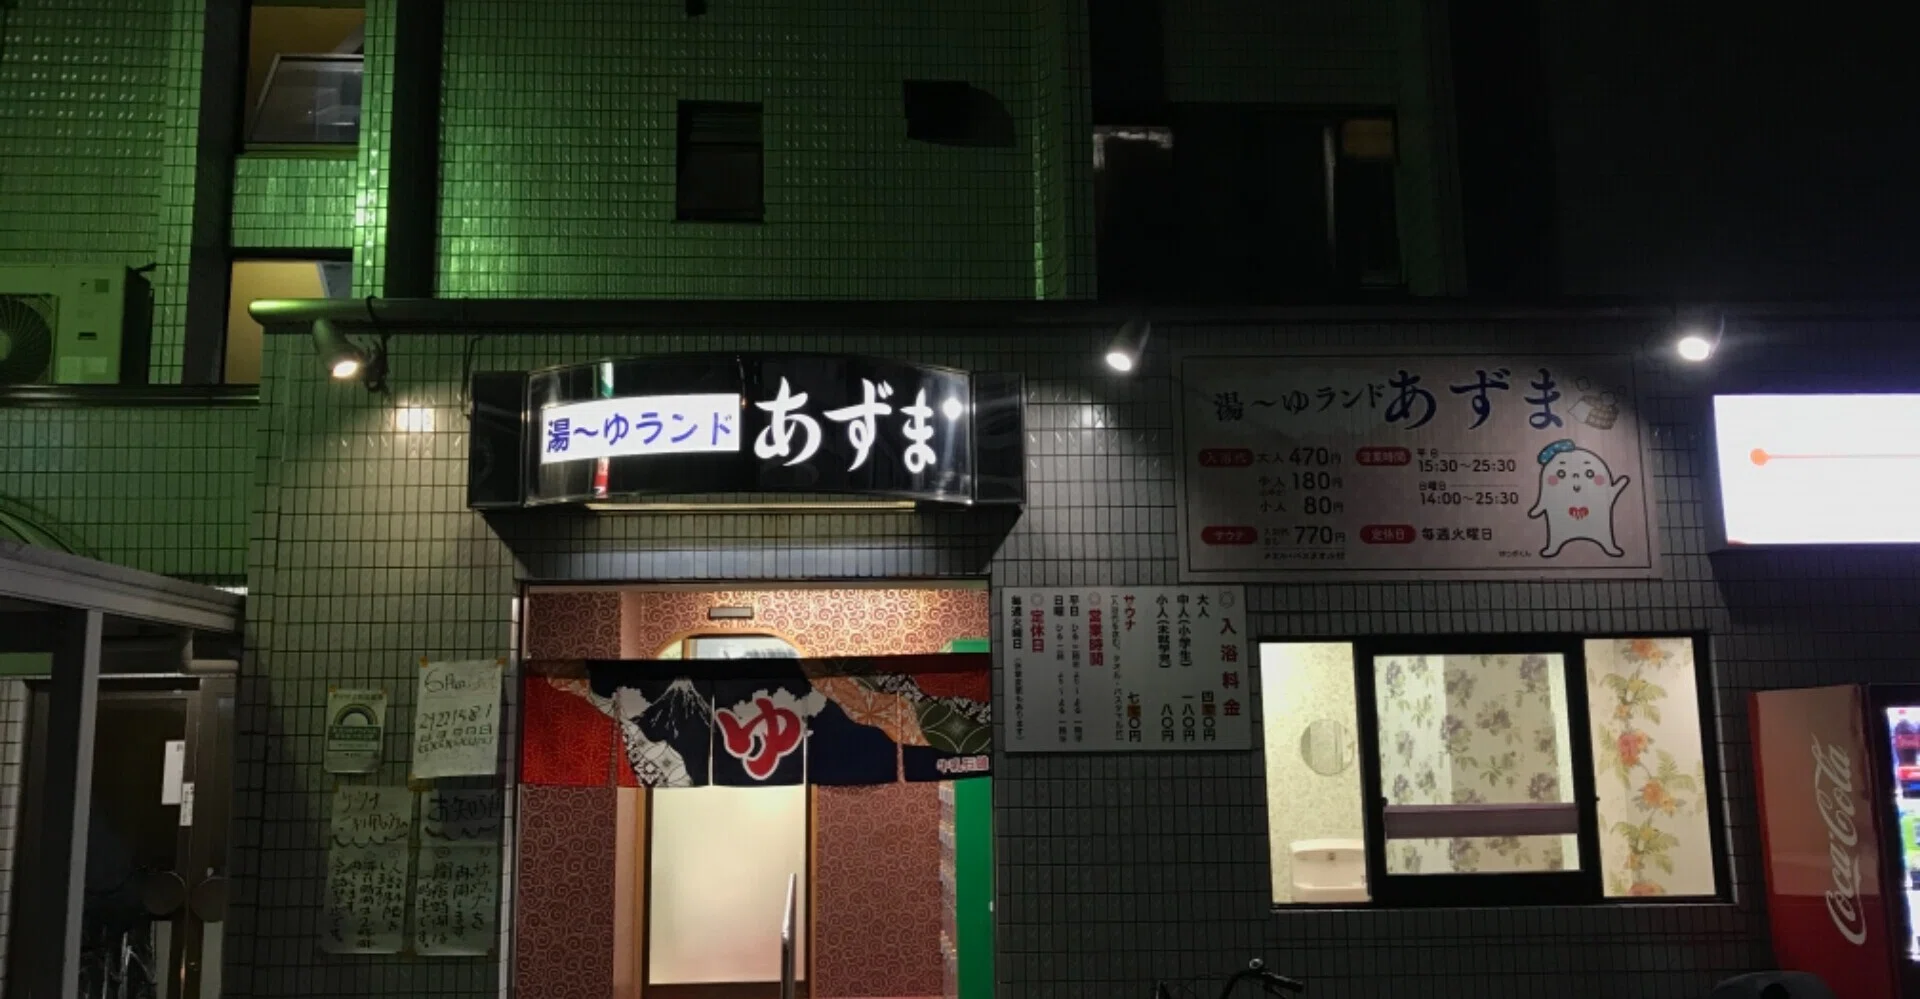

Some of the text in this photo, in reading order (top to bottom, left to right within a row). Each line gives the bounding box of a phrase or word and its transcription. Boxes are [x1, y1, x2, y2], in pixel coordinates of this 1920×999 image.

[1384, 367, 1564, 431] あずま
[753, 375, 939, 475] あずま
[1256, 447, 1342, 466] 大人 470円
[1359, 450, 1407, 463] 営業時間
[1417, 448, 1440, 458] 平日
[1292, 471, 1343, 490] 180円
[1419, 481, 1447, 491] 日曜日
[1260, 495, 1345, 514] 小人 80円
[1211, 530, 1247, 541] サウナ
[1294, 526, 1346, 545] 770円
[1371, 529, 1406, 541] 定休日
[1421, 528, 1493, 541] 毎週火曜日
[1053, 594, 1065, 617] 日曜
[1069, 595, 1080, 617] 平日
[1123, 594, 1137, 632] サウナ
[1197, 594, 1211, 618] 大人
[1011, 595, 1023, 650] 毎週火曜日
[1030, 609, 1045, 654] 定休日
[1088, 609, 1104, 667] 営業時間
[1220, 617, 1241, 717] 入浴料金
[713, 696, 803, 781] ゆ
